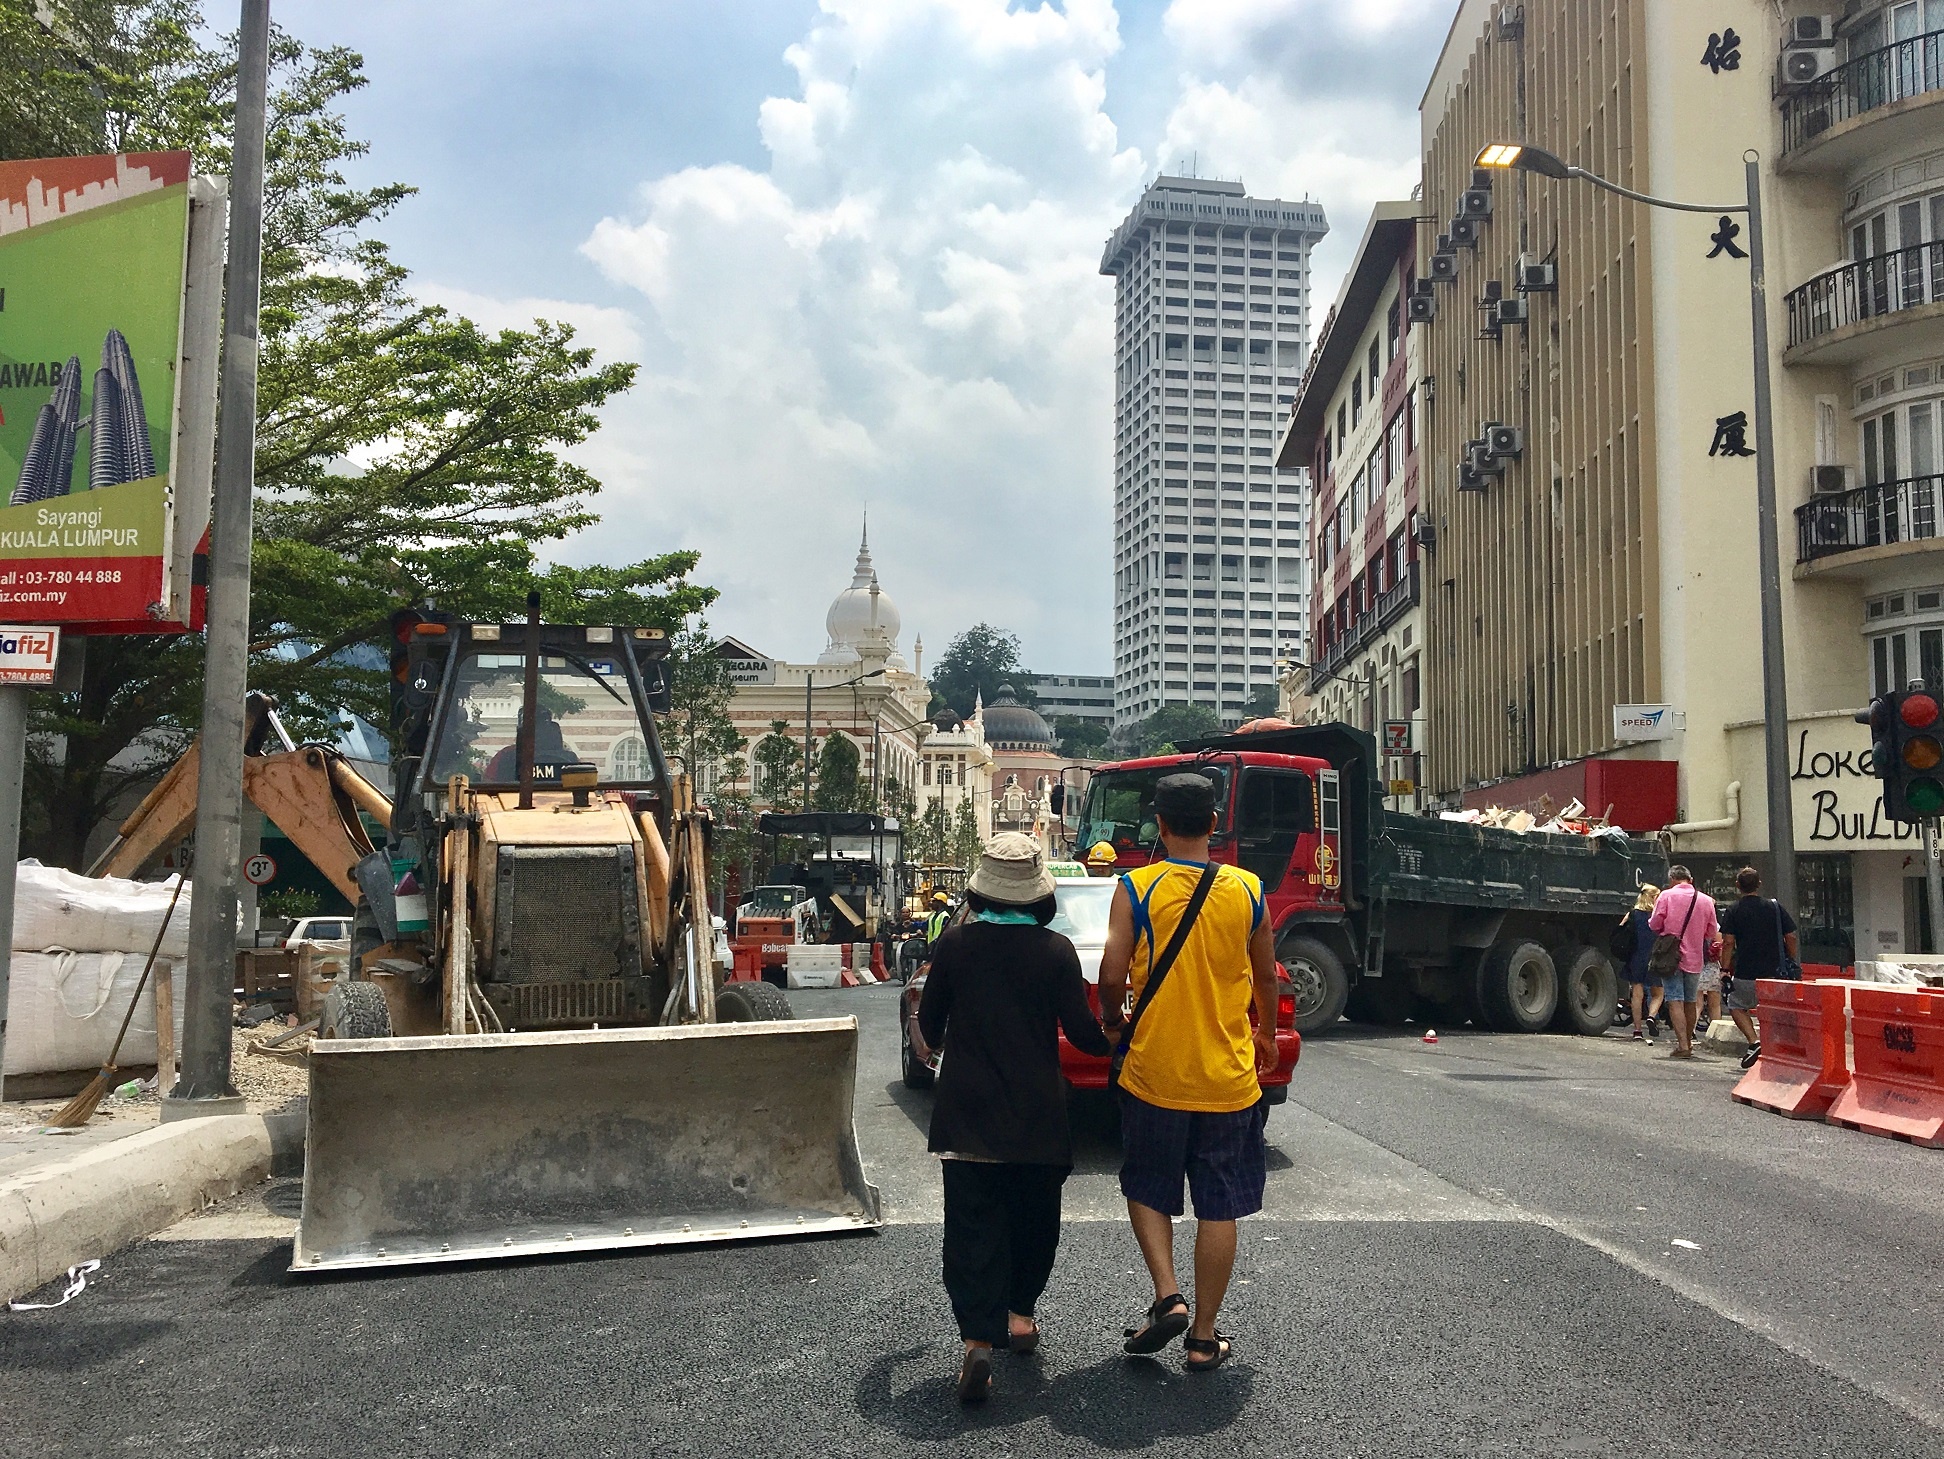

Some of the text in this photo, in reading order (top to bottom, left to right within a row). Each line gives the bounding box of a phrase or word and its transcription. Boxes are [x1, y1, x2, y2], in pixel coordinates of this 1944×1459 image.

[37, 507, 102, 529] Sayangi
[1, 528, 138, 549] KUALA LUMPUR
[76, 571, 93, 583] 44
[96, 570, 122, 583] 888
[1389, 726, 1407, 747] 7
